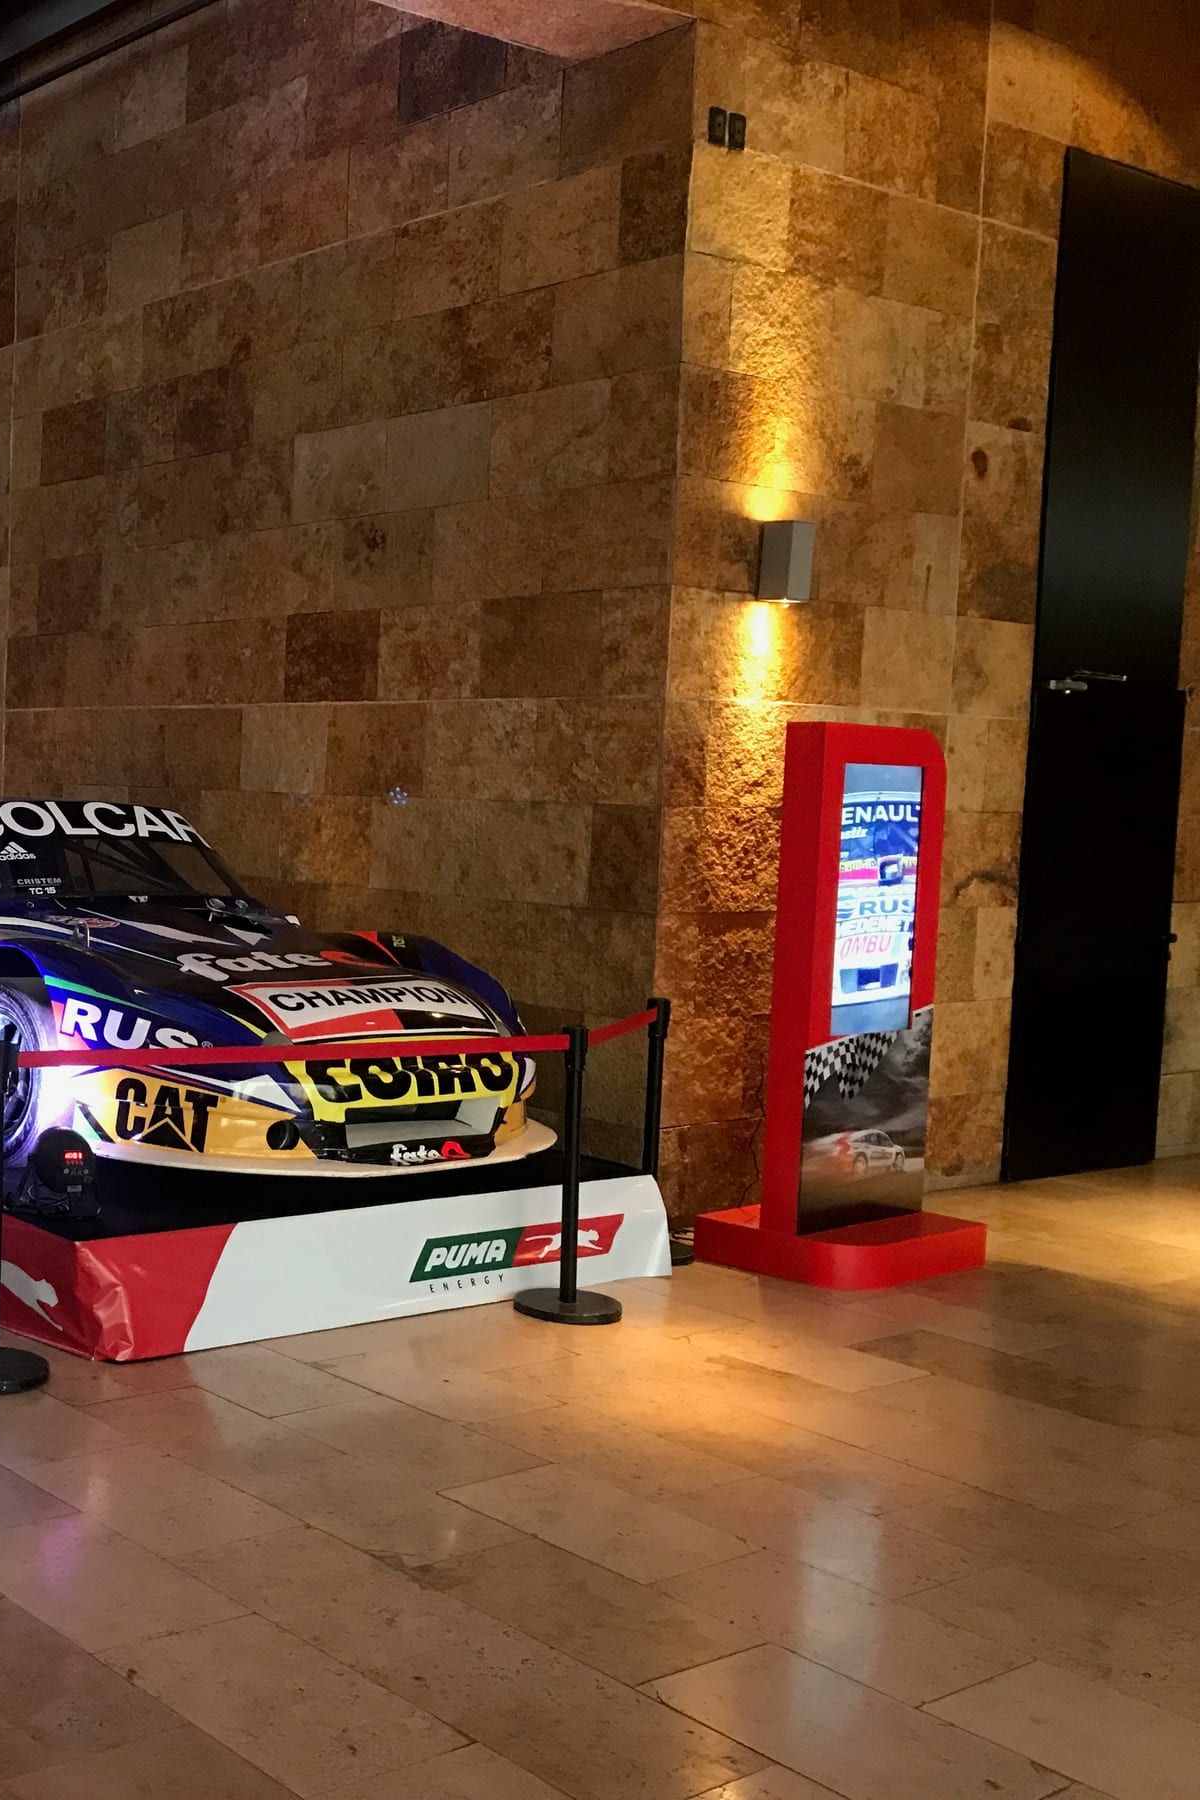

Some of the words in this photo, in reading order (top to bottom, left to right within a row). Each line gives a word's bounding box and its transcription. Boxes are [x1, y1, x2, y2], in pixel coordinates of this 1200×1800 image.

[28, 887, 43, 895] TC
[176, 951, 333, 982] fate
[267, 985, 467, 1012] CHAMPION
[115, 1077, 219, 1153] CAT
[390, 1143, 446, 1166] fate
[424, 1238, 507, 1273] PUMA
[429, 1273, 504, 1294] ENERGY
